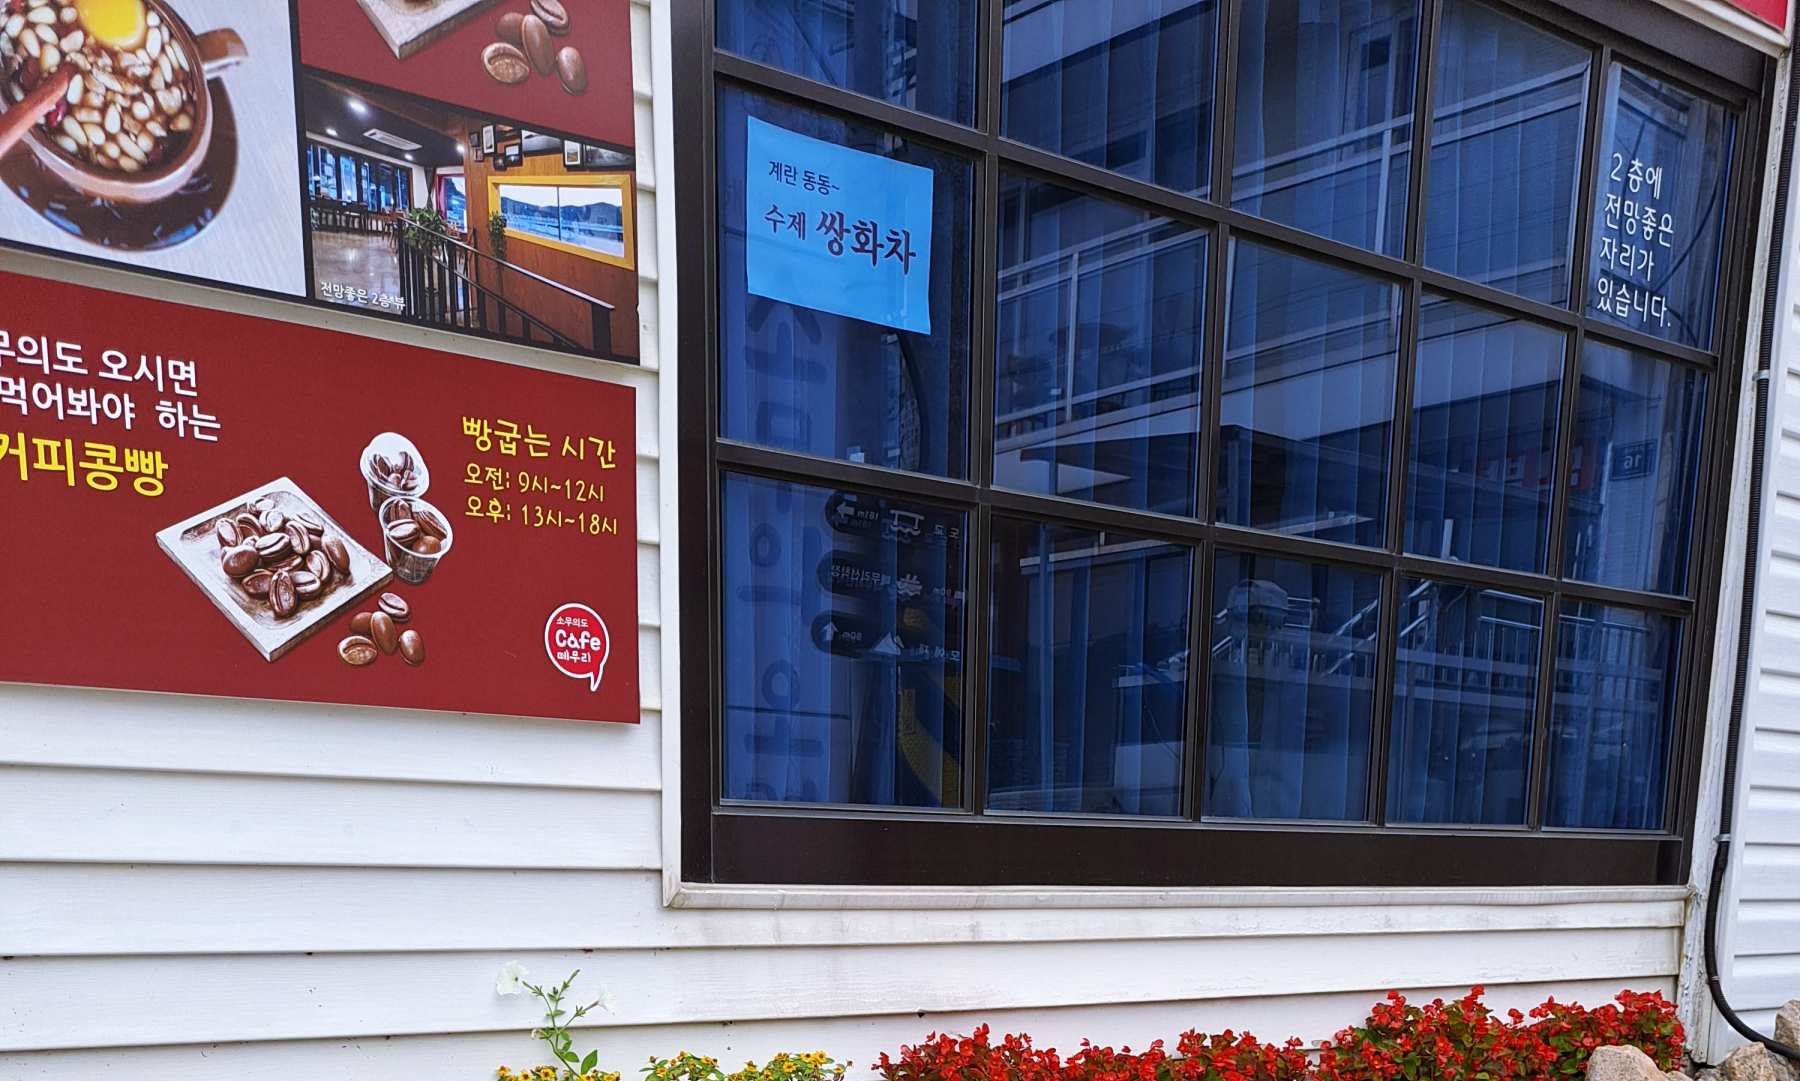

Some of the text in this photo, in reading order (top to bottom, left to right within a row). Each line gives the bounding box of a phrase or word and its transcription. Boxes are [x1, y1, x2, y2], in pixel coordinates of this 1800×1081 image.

[769, 160, 840, 196] 계란 동동~
[764, 204, 917, 275] 수제 쌍화차
[1604, 193, 1674, 248] 전망좋은
[1600, 236, 1655, 282] 자리가
[321, 281, 368, 304] 전망좋은
[1597, 278, 1671, 328] 있습니다.
[98, 349, 198, 397] 오시면
[0, 376, 221, 442] 먹어봐야 하는
[462, 416, 616, 469] 빵굽는 시간
[464, 463, 604, 502] 오전: 9시~12시
[465, 496, 617, 535] 오후: 13시~18시
[555, 629, 601, 651] Cafe
[556, 616, 589, 628] 소무의도
